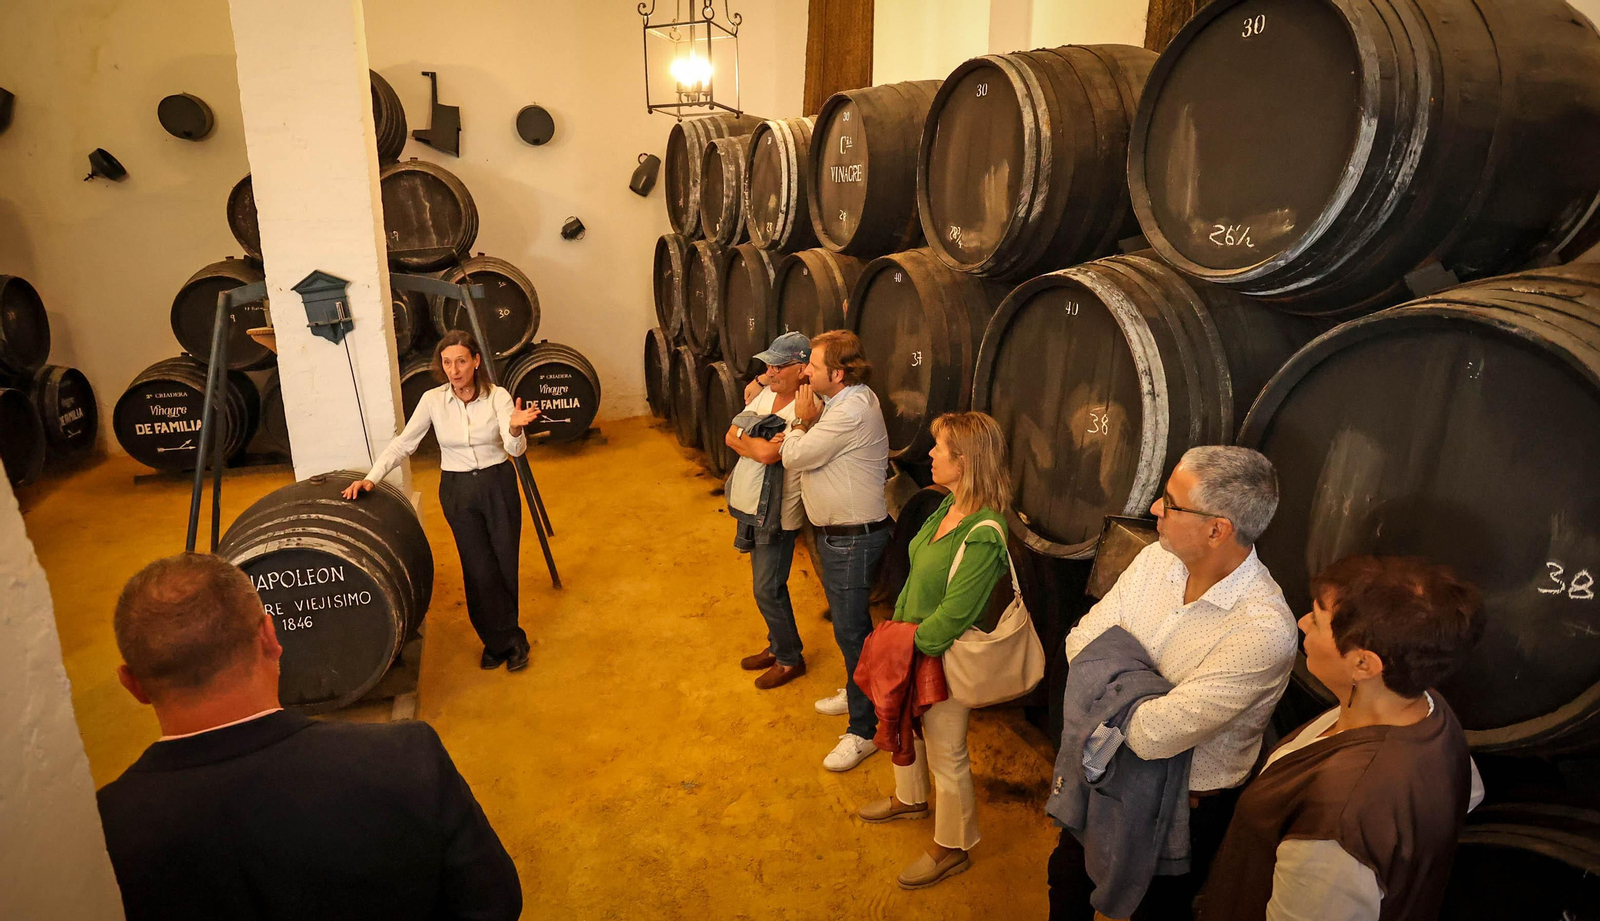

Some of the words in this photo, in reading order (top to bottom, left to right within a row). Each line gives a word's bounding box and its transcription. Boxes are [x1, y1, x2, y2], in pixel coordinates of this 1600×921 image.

[1242, 14, 1266, 38] 30
[976, 83, 988, 97] 30
[894, 272, 902, 283] 40
[498, 308, 510, 319] 30
[1065, 301, 1079, 316] 40
[911, 350, 923, 367] 37
[154, 391, 188, 399] CRIADERA
[539, 383, 569, 396] Vinagre
[149, 404, 188, 418] Vinagre
[526, 401, 539, 410] DE
[541, 398, 580, 410] FAMILIA
[135, 423, 153, 436] DE
[154, 419, 203, 435] FAMILIA
[1087, 413, 1109, 436] 38
[1537, 561, 1595, 600] 38
[294, 590, 372, 612] VIEJISIMO
[282, 615, 313, 631] 1846
